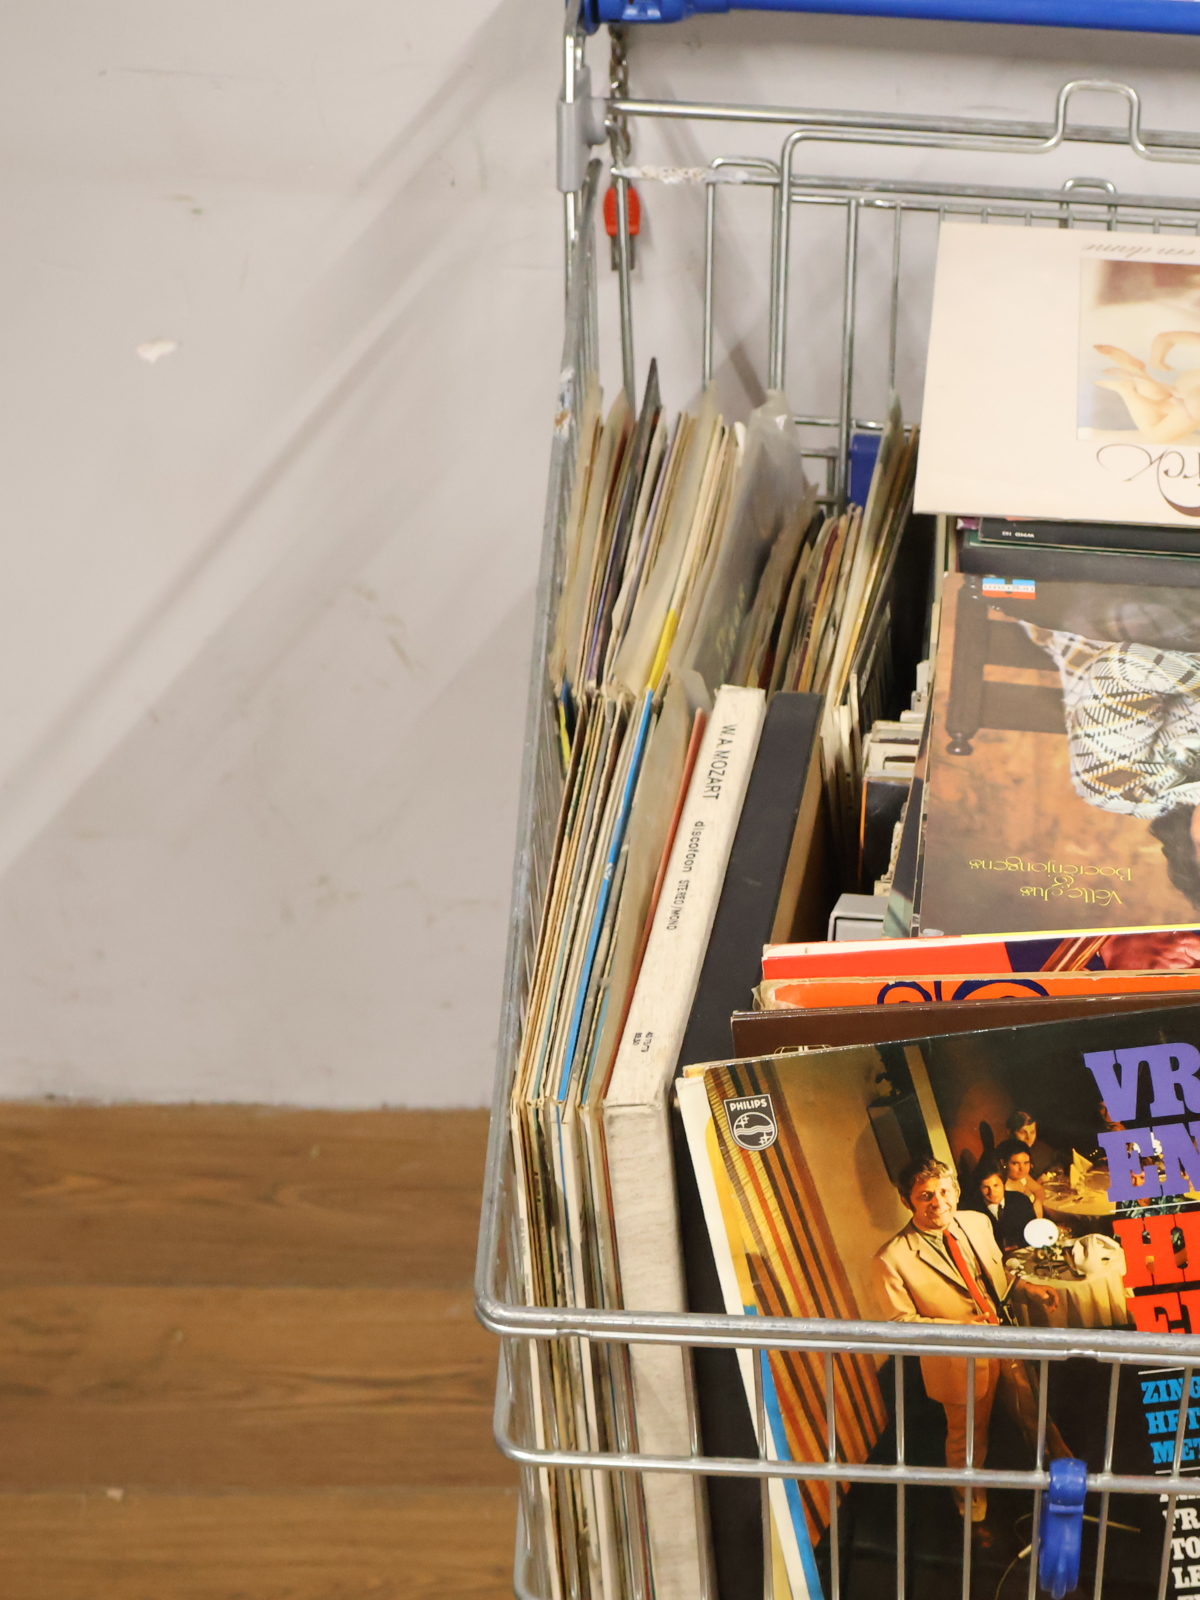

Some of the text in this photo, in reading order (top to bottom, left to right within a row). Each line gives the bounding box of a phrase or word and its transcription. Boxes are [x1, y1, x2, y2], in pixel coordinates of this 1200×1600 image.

[702, 747, 731, 800] MOZART
[681, 820, 705, 873] discofoon
[969, 856, 1132, 882] Boerenjongens
[1051, 874, 1075, 889] &
[1019, 886, 1064, 902] Jus
[729, 1097, 768, 1111] PHILIPS
